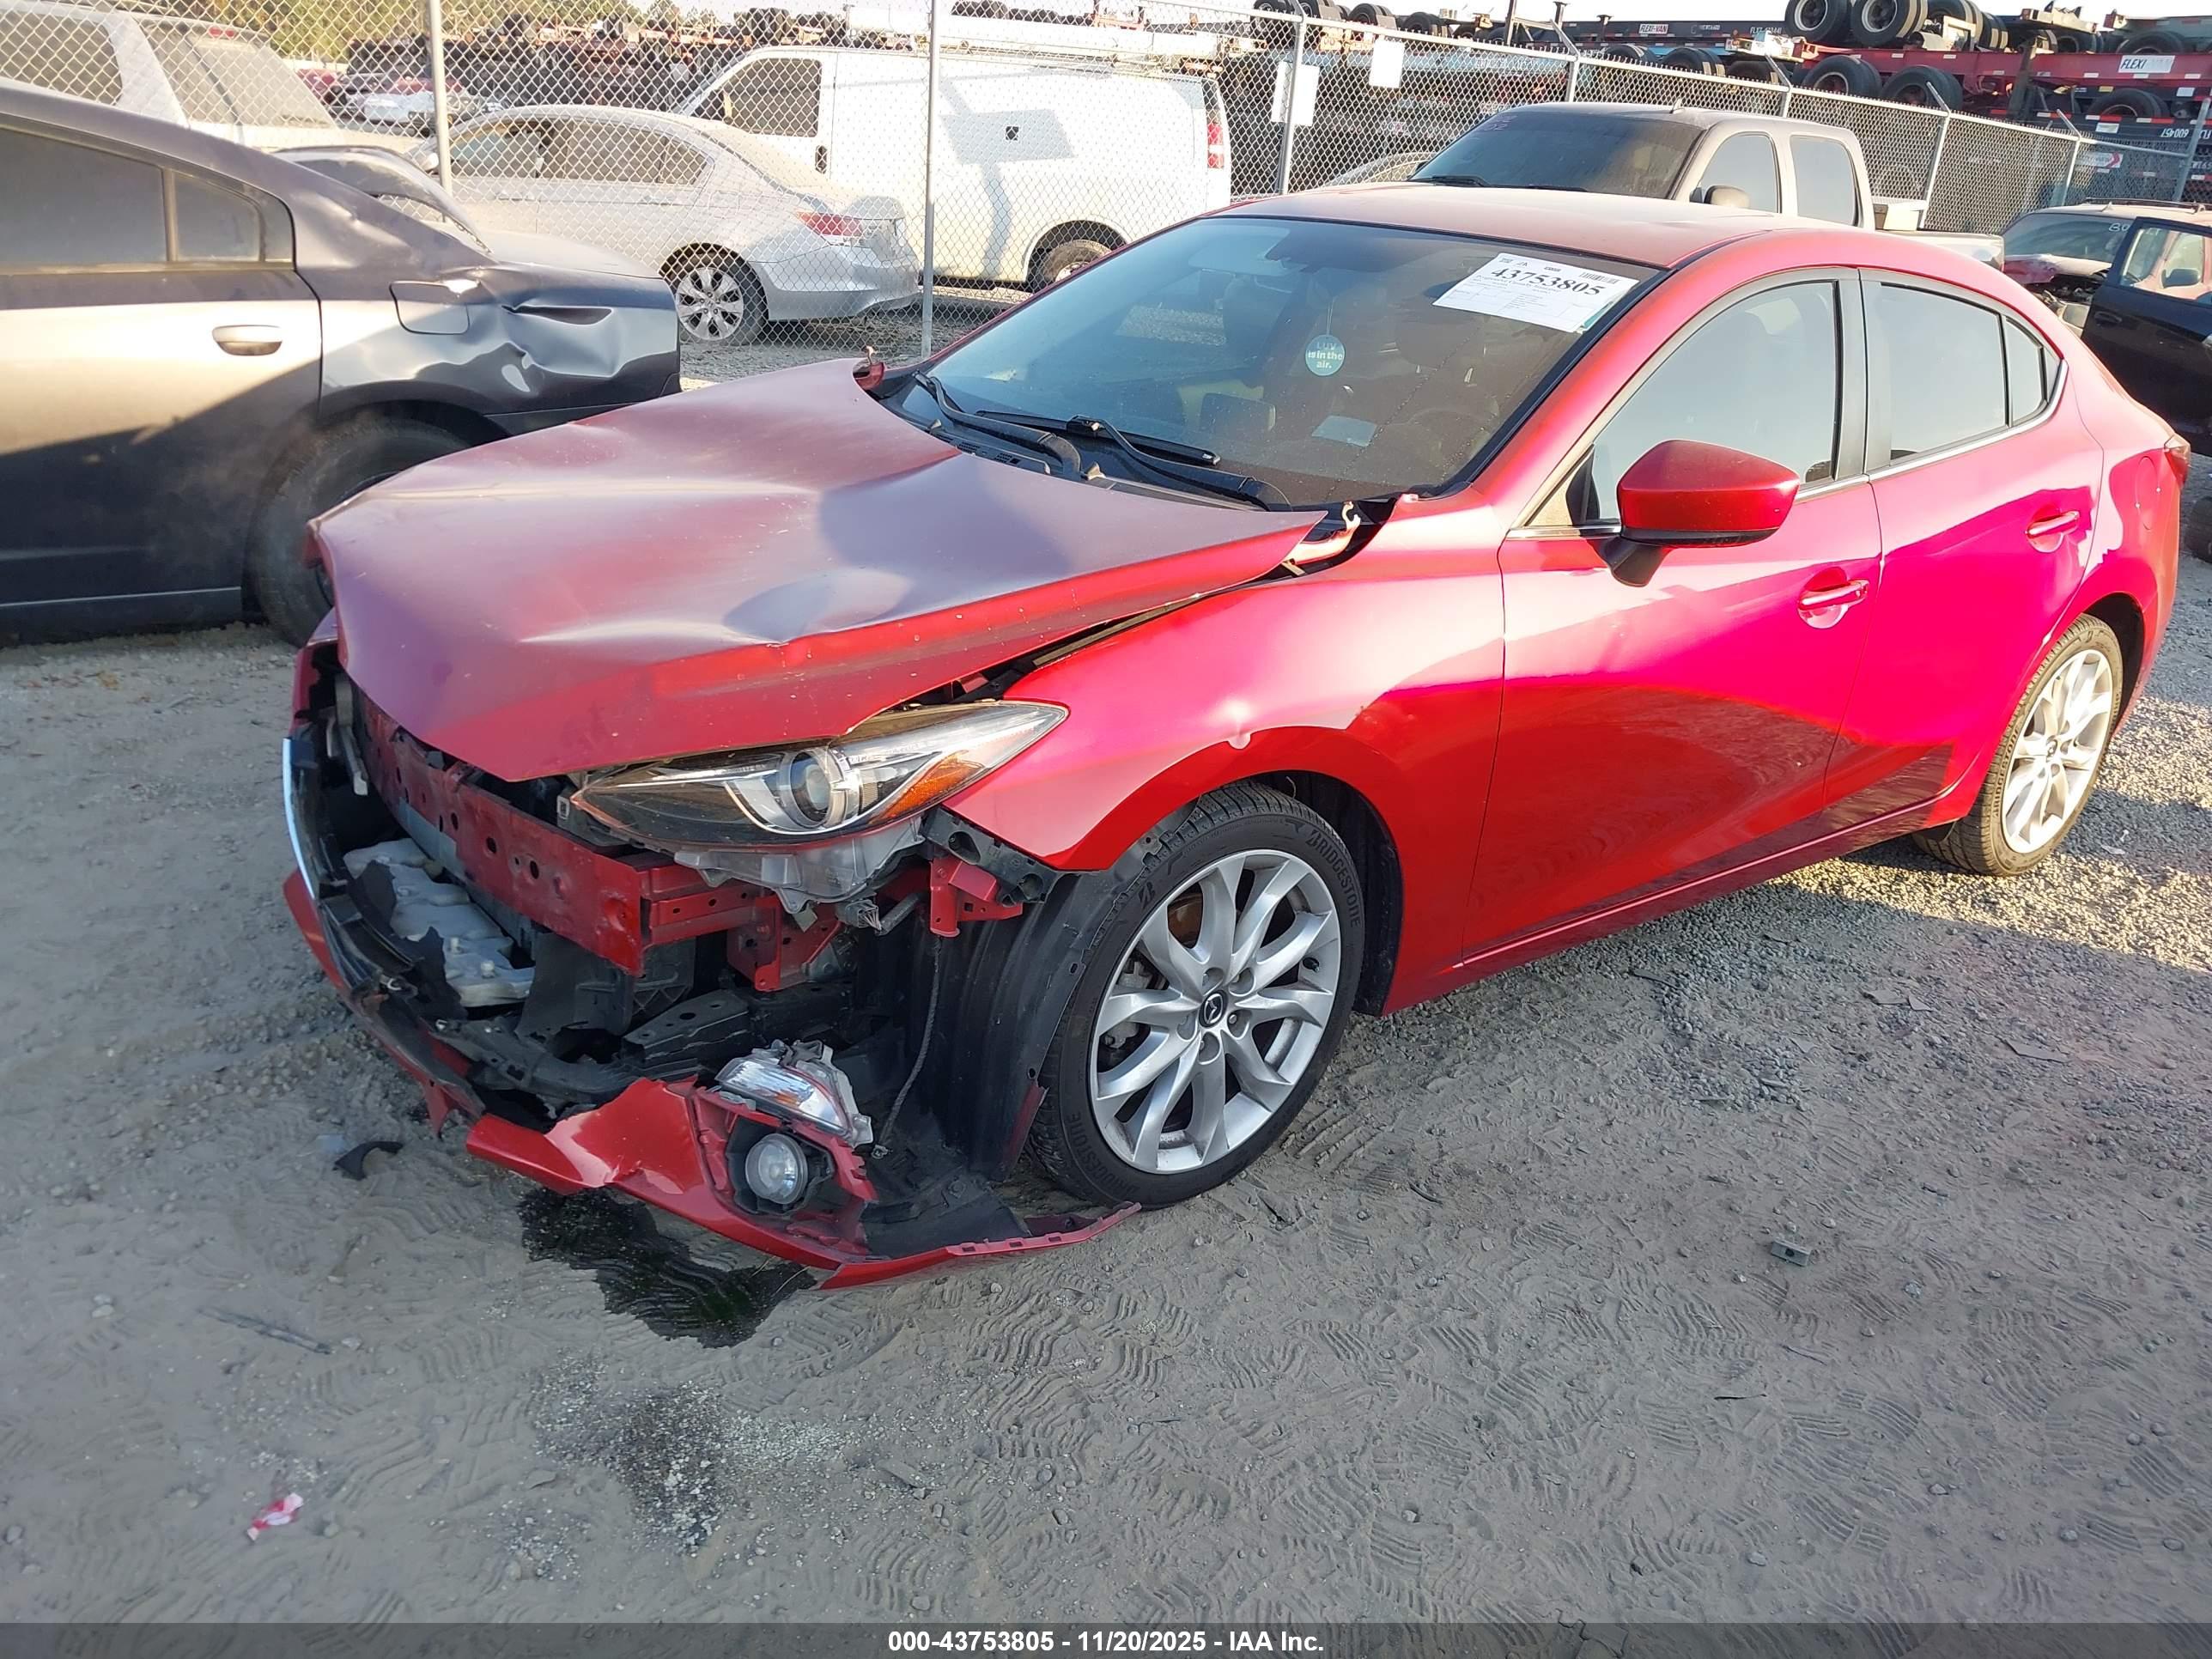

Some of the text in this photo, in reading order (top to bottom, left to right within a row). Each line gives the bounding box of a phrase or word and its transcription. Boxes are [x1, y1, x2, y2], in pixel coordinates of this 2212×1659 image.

[2120, 58, 2148, 70] FLEXI
[1491, 267, 1606, 295] 43753805
[1327, 351, 1344, 361] the
[1306, 830, 1361, 928] BRIDGESTONE
